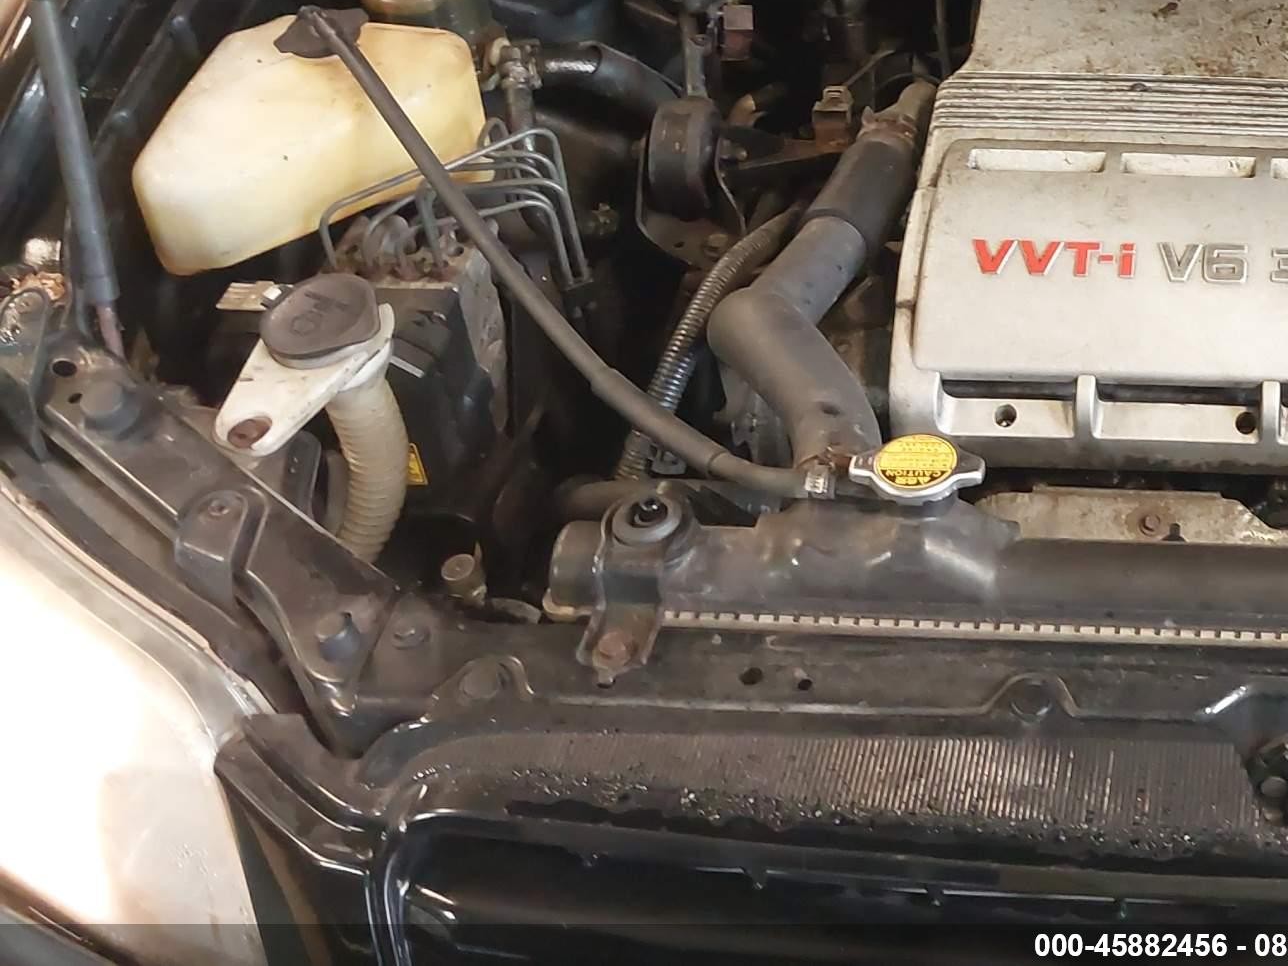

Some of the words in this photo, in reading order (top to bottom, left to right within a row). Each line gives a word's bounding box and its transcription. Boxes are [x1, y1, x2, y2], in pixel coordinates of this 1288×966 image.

[972, 239, 1136, 278] VVT-i
[1158, 241, 1248, 284] V6
[886, 469, 941, 477] CAUTION
